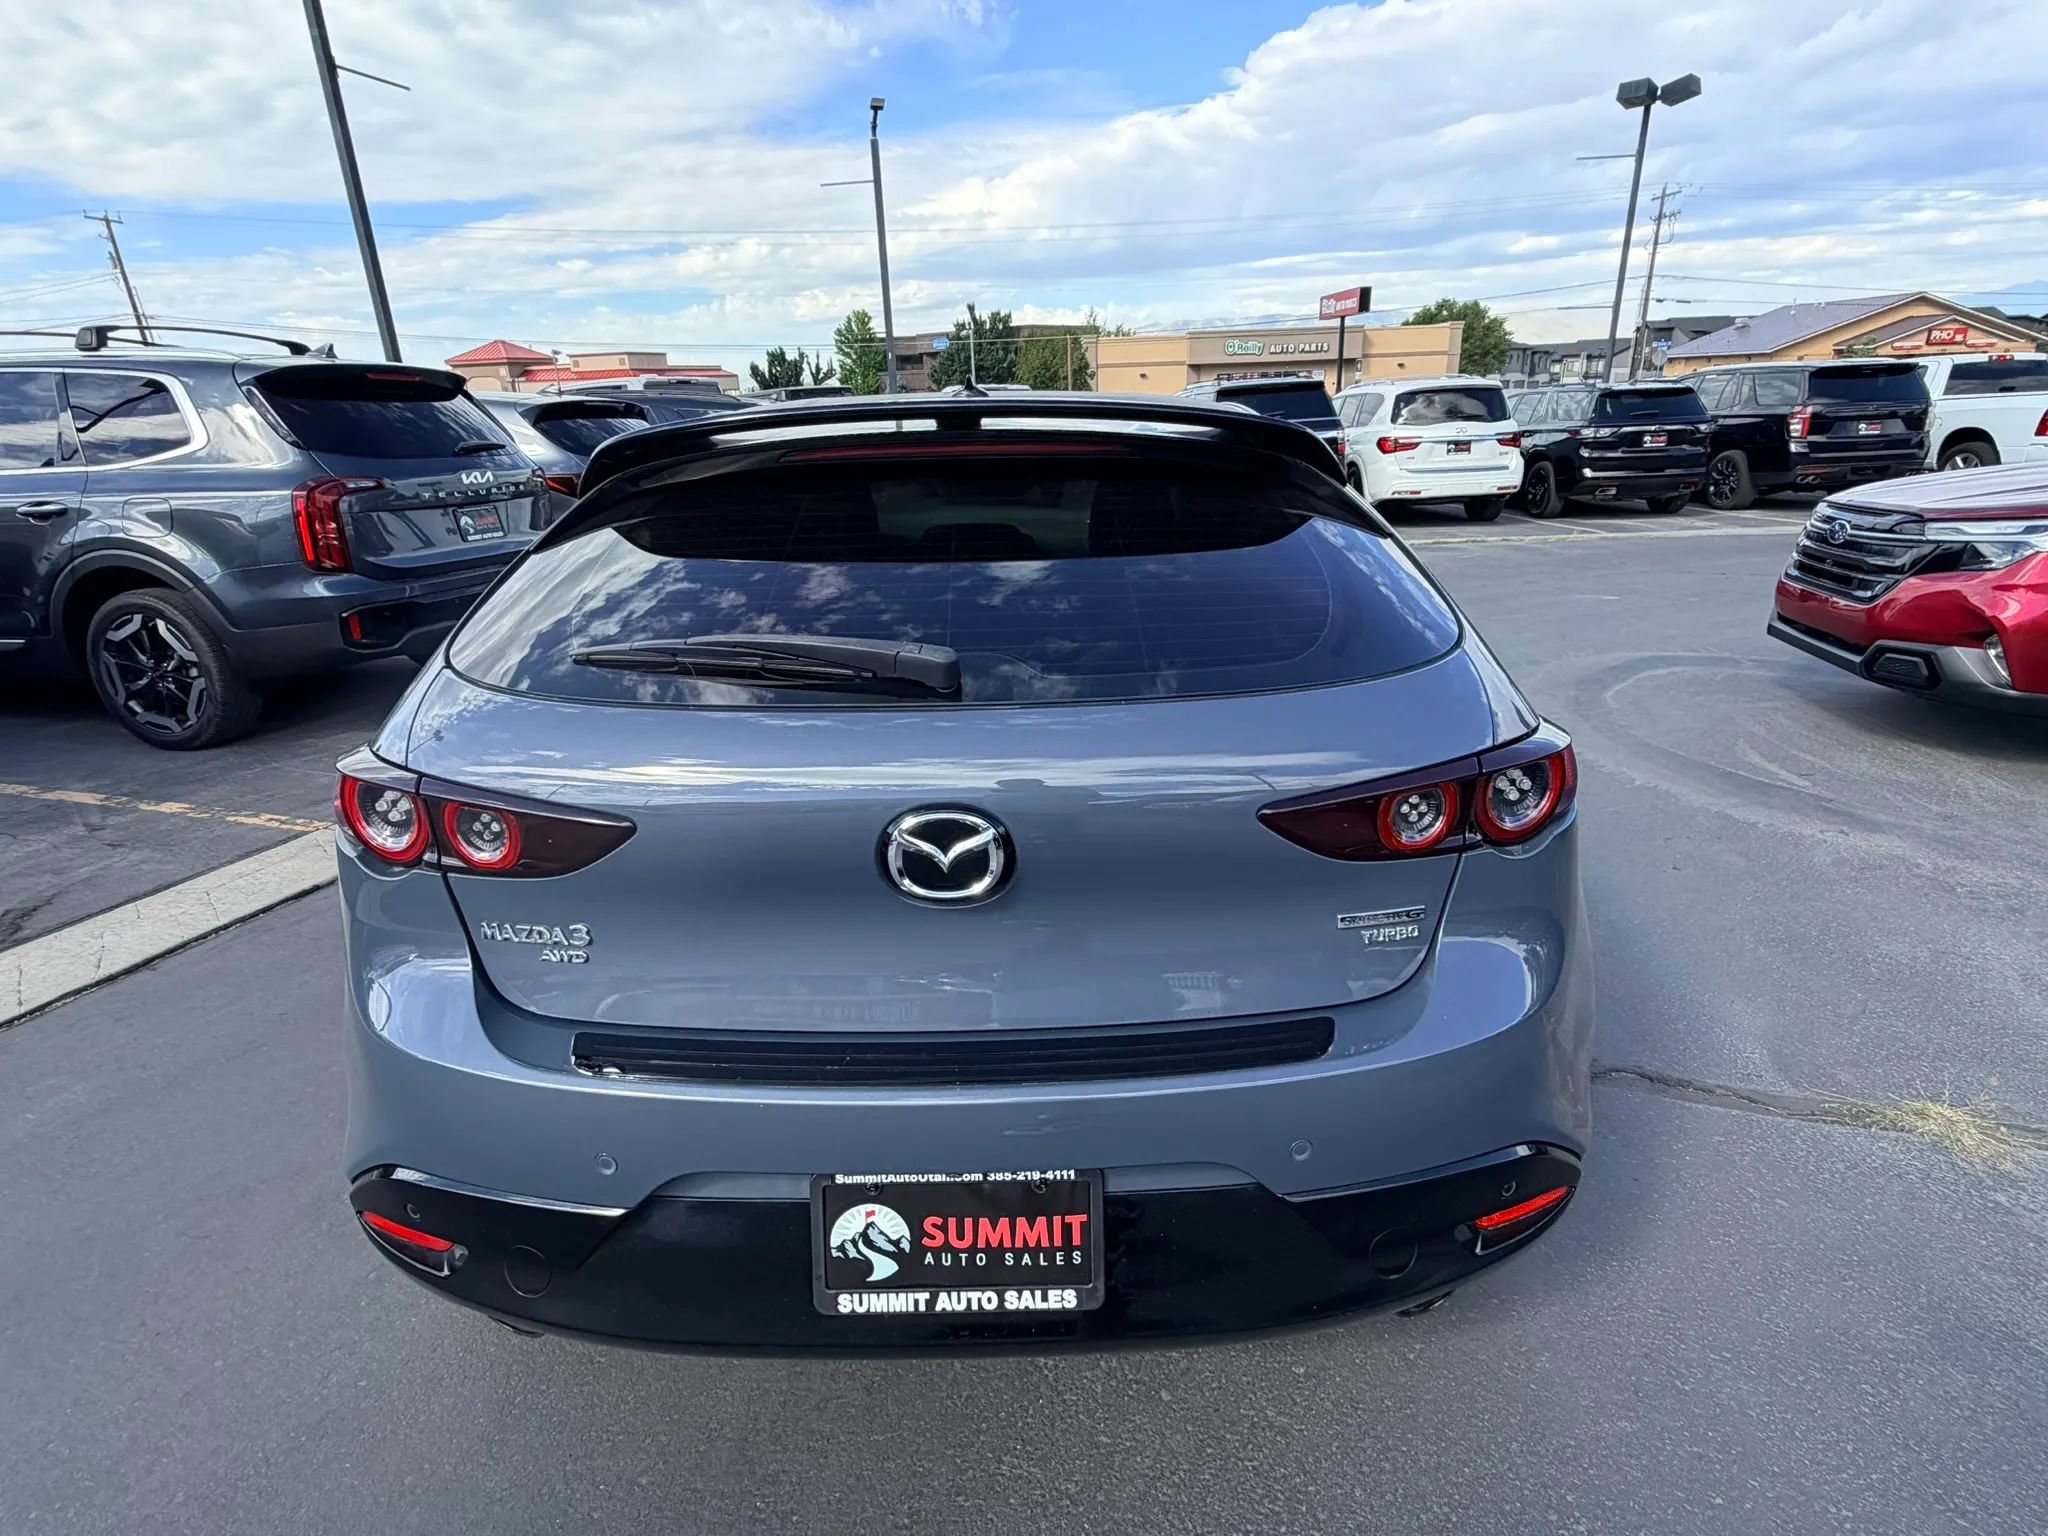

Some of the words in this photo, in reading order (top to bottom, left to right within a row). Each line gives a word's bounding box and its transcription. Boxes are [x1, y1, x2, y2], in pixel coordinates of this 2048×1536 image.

[1930, 330, 1954, 340] PHO
[1225, 340, 1265, 357] O'Reilly
[1269, 343, 1294, 354] AUTO
[1298, 342, 1329, 353] PARTS
[422, 484, 525, 499] TELLURIDE
[1361, 925, 1419, 944] TURBO
[540, 949, 589, 963] AWD
[921, 1213, 1088, 1250] SUMMIT
[924, 1252, 987, 1267] AUTO
[1004, 1251, 1082, 1266] SALES
[837, 1292, 931, 1314] SUMMIT
[934, 1291, 999, 1312] AUTO
[1003, 1289, 1078, 1310] SALES
